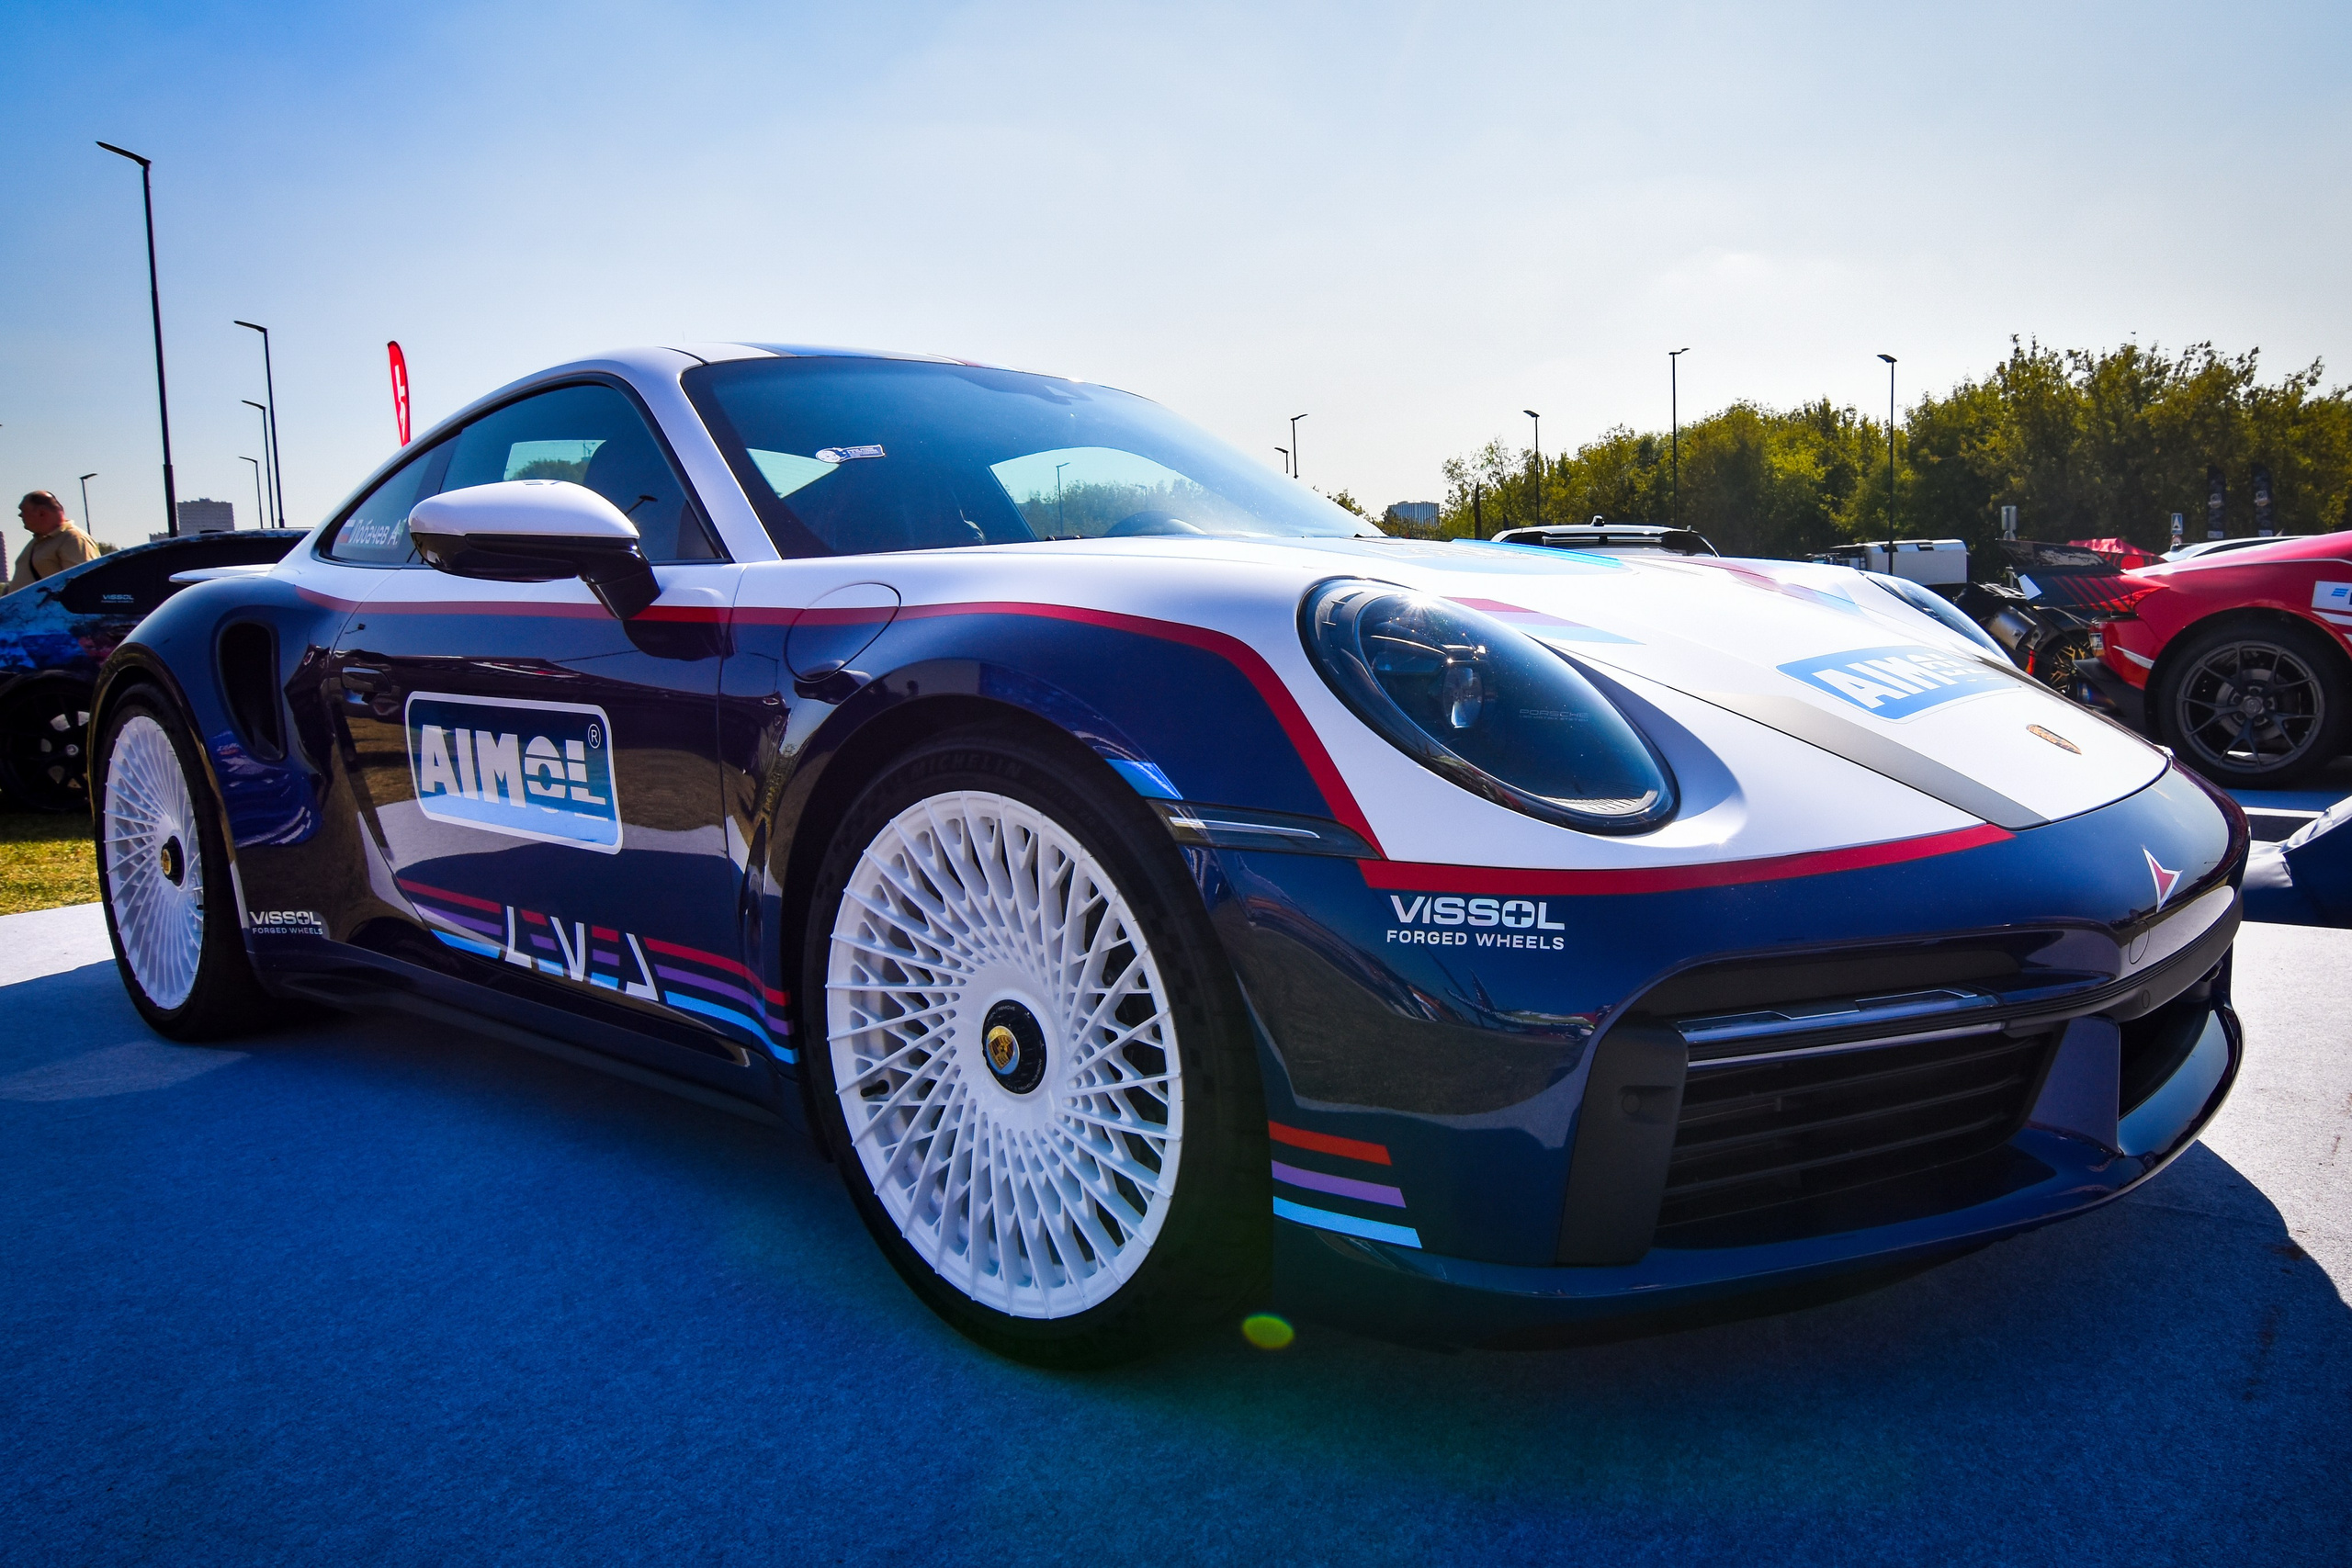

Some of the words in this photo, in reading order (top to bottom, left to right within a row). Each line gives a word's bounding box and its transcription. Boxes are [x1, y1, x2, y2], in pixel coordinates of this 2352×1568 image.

[349, 519, 390, 546] Лобачев
[1519, 708, 1589, 718] PORSCHE
[910, 752, 1022, 779] MICHELIN
[250, 910, 322, 925] VISSOL
[1389, 894, 1566, 931] VISSOL
[288, 927, 323, 935] WHEELS
[1385, 930, 1468, 946] FORGED
[1475, 932, 1566, 951] WHEELS
